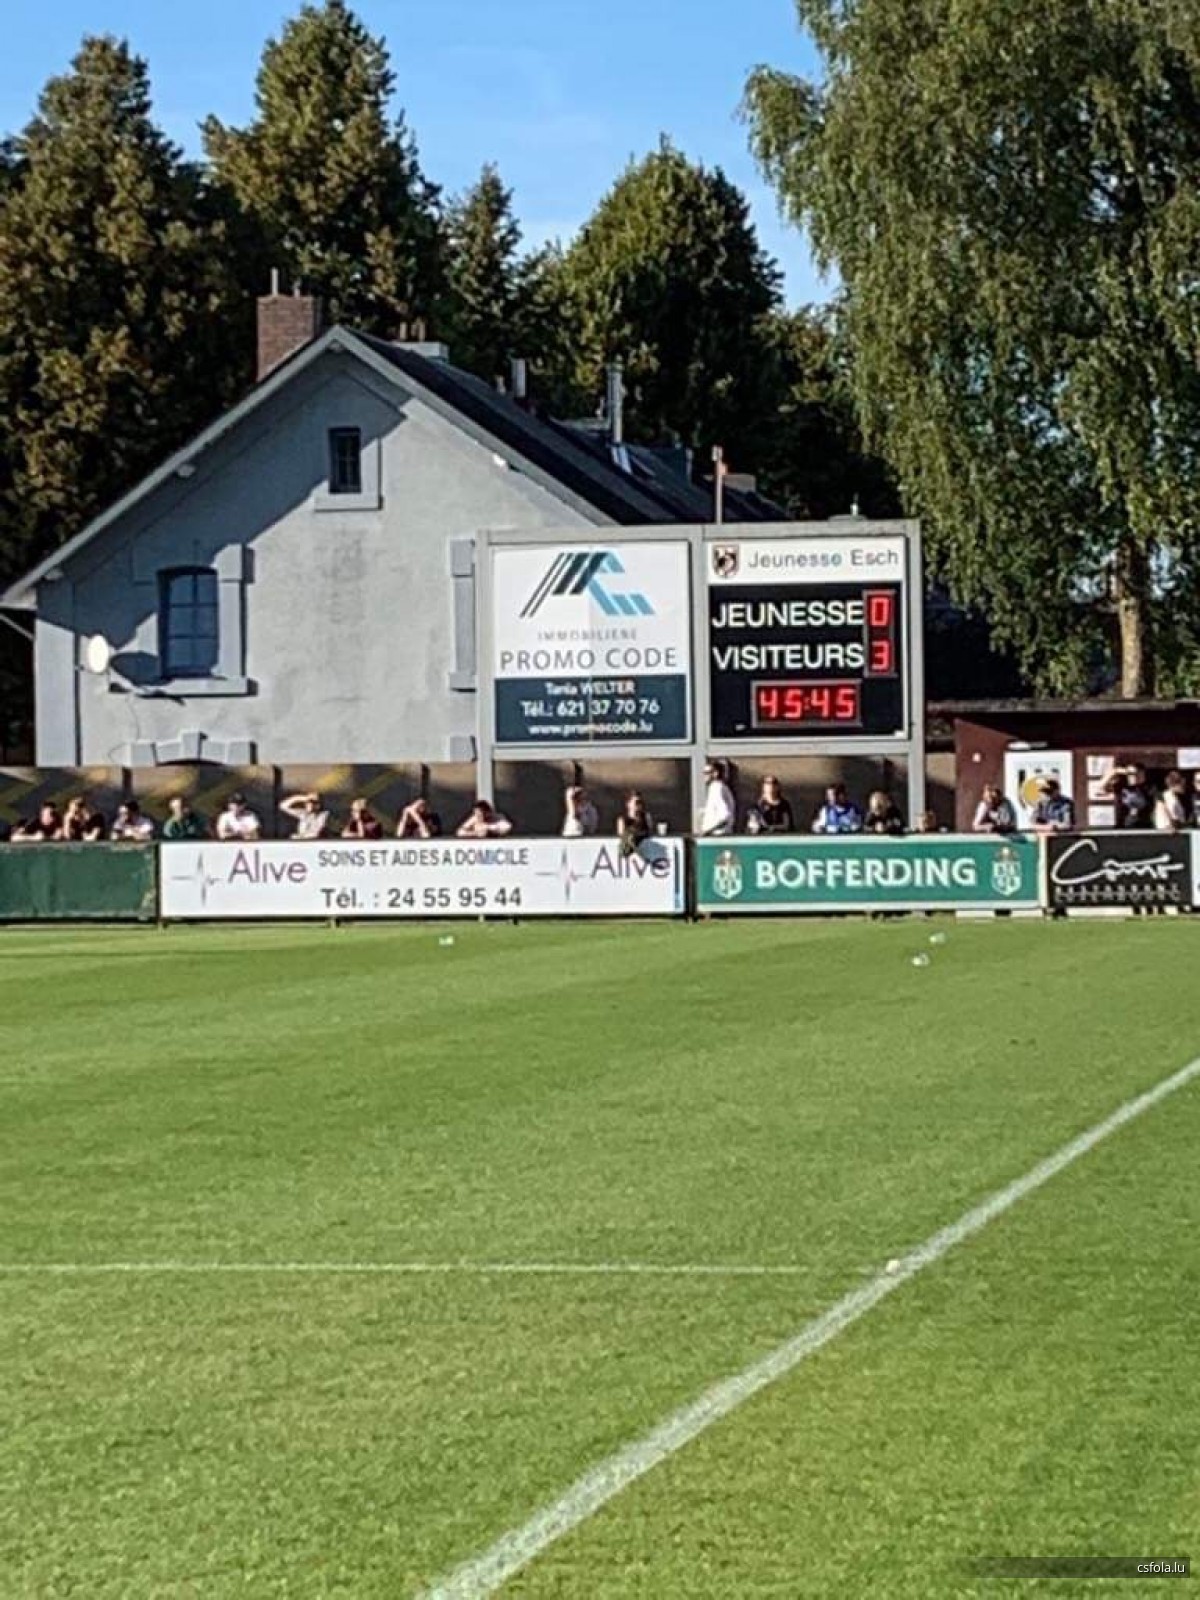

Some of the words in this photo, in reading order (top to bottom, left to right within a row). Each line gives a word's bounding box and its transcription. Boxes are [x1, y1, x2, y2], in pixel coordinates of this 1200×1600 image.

[748, 551, 842, 568] Jeunesse
[851, 548, 899, 566] Esch
[712, 600, 864, 628] JEUNESSE
[871, 597, 890, 626] 0
[501, 650, 596, 671] PROMO
[605, 648, 677, 668] CODE
[712, 643, 864, 670] VISITEURS
[871, 640, 890, 669] 3
[557, 699, 585, 717] 621
[590, 699, 611, 715] 37
[614, 699, 636, 715] 70
[639, 698, 660, 715] 76
[759, 688, 856, 718] 45:45
[228, 849, 307, 883] Alive
[318, 849, 365, 867] SOINS
[369, 849, 388, 866] ET
[391, 848, 439, 866] AIDES
[455, 847, 529, 865] DOMICILE
[756, 857, 977, 888] BOFFERDING
[387, 887, 415, 908] 24
[423, 887, 451, 908] 55
[458, 886, 487, 907] 95
[494, 886, 521, 907] 44
